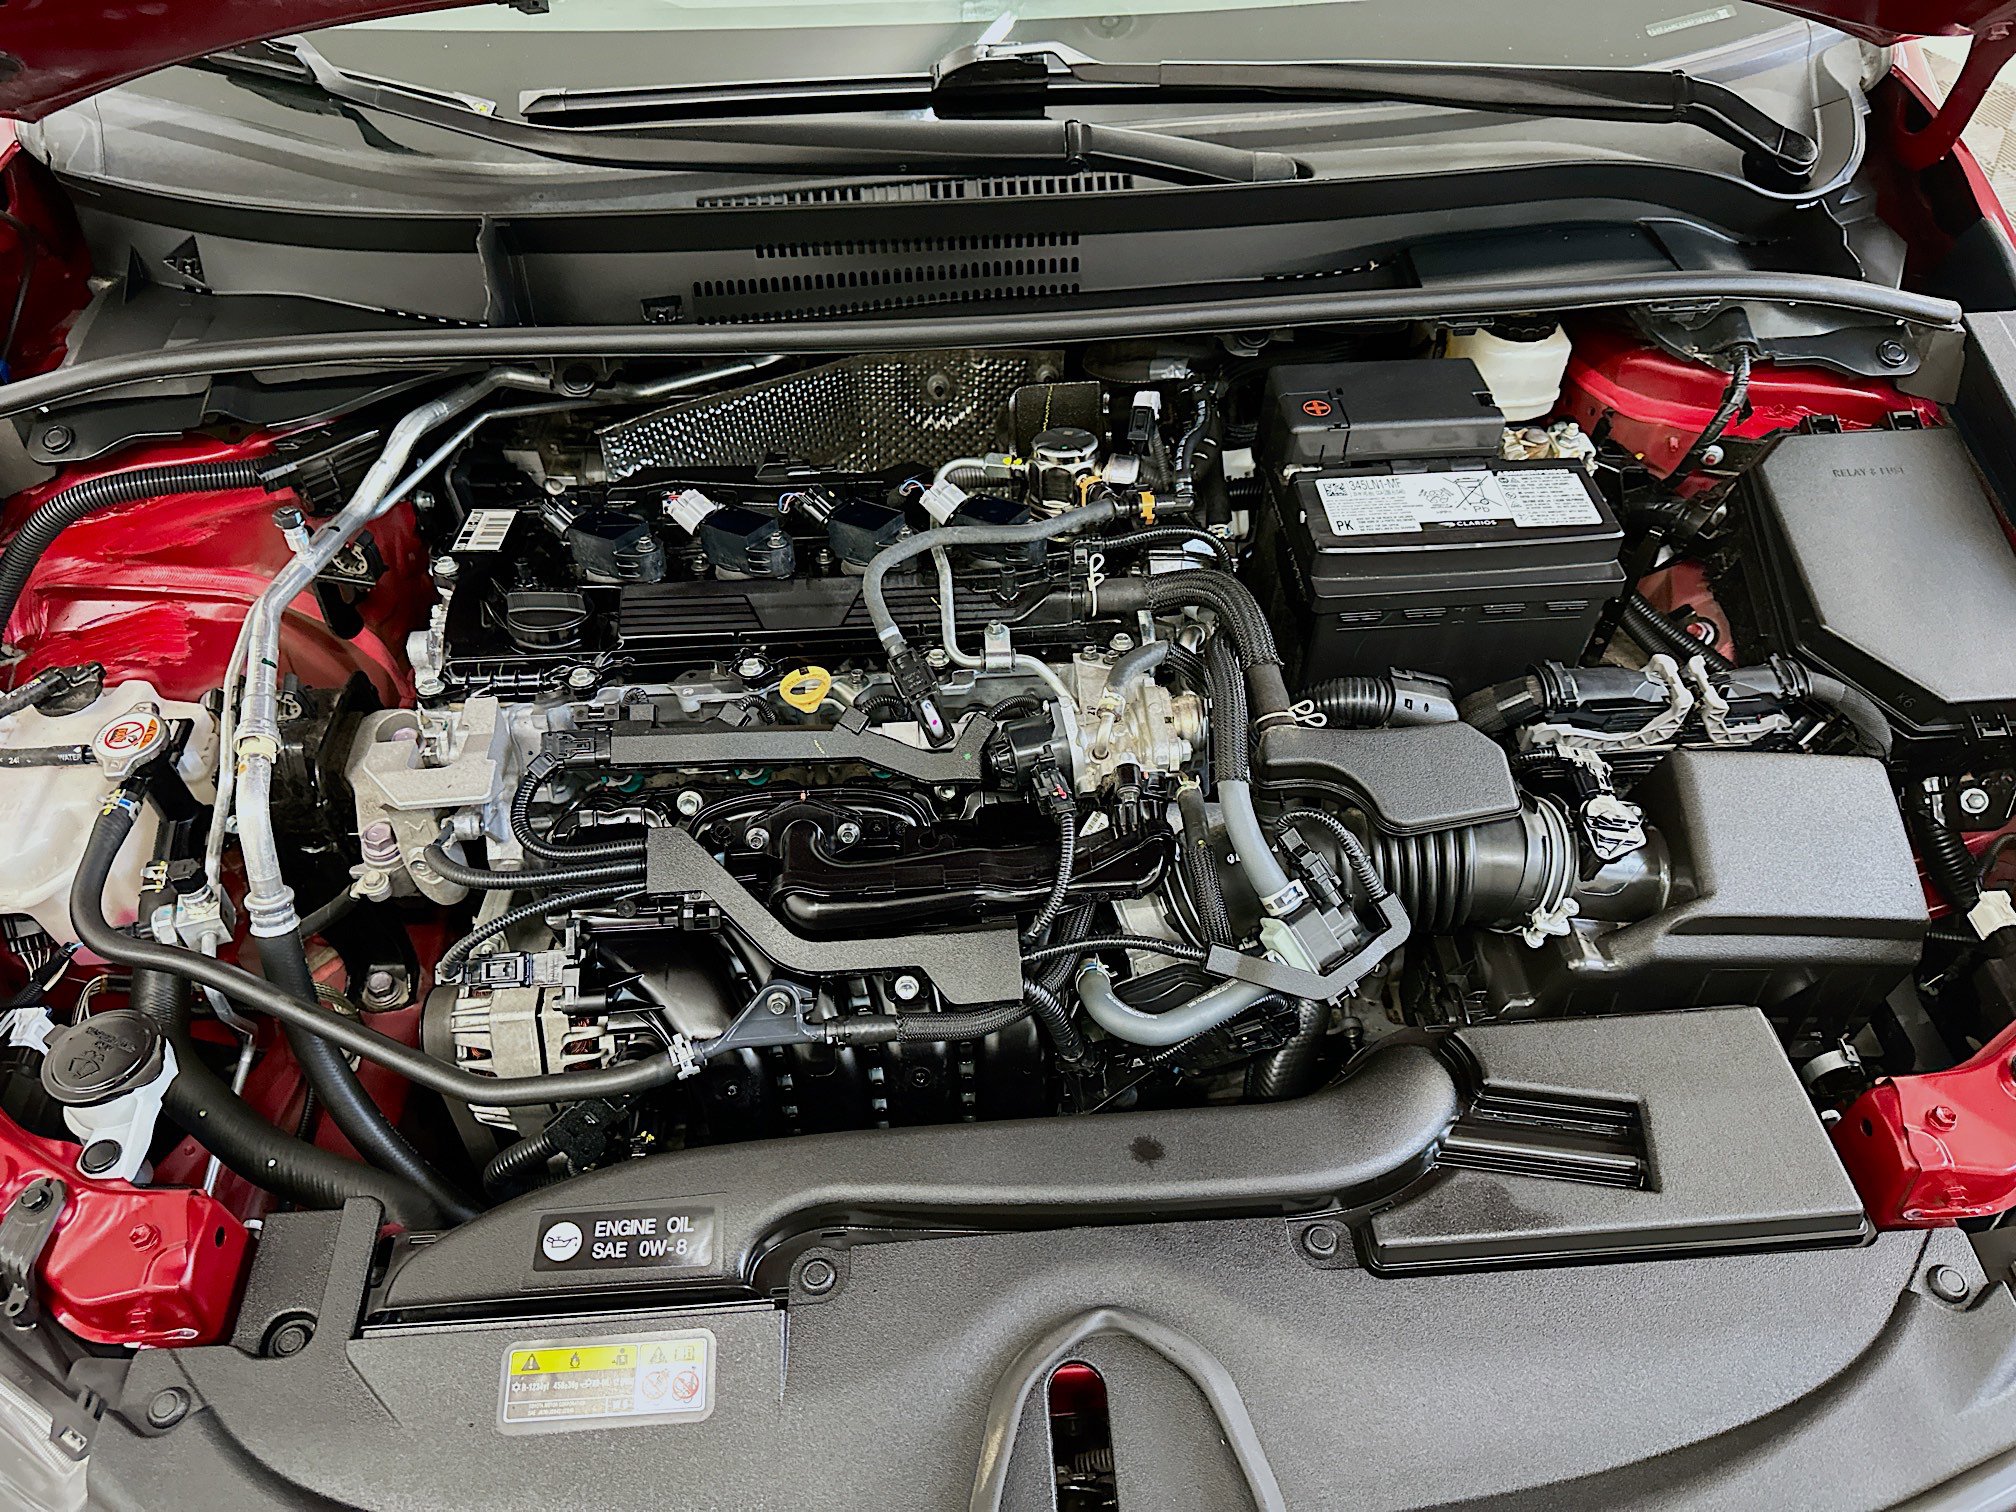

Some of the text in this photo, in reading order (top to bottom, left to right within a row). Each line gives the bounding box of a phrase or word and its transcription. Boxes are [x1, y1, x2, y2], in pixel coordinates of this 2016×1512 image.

[1473, 505, 1491, 514] Pb
[1336, 520, 1355, 532] PK
[1456, 519, 1498, 528] CLARIOS
[57, 752, 82, 762] WATER
[594, 1216, 695, 1238] ENGINE OIL
[591, 1239, 688, 1260] SAE 0W-8
